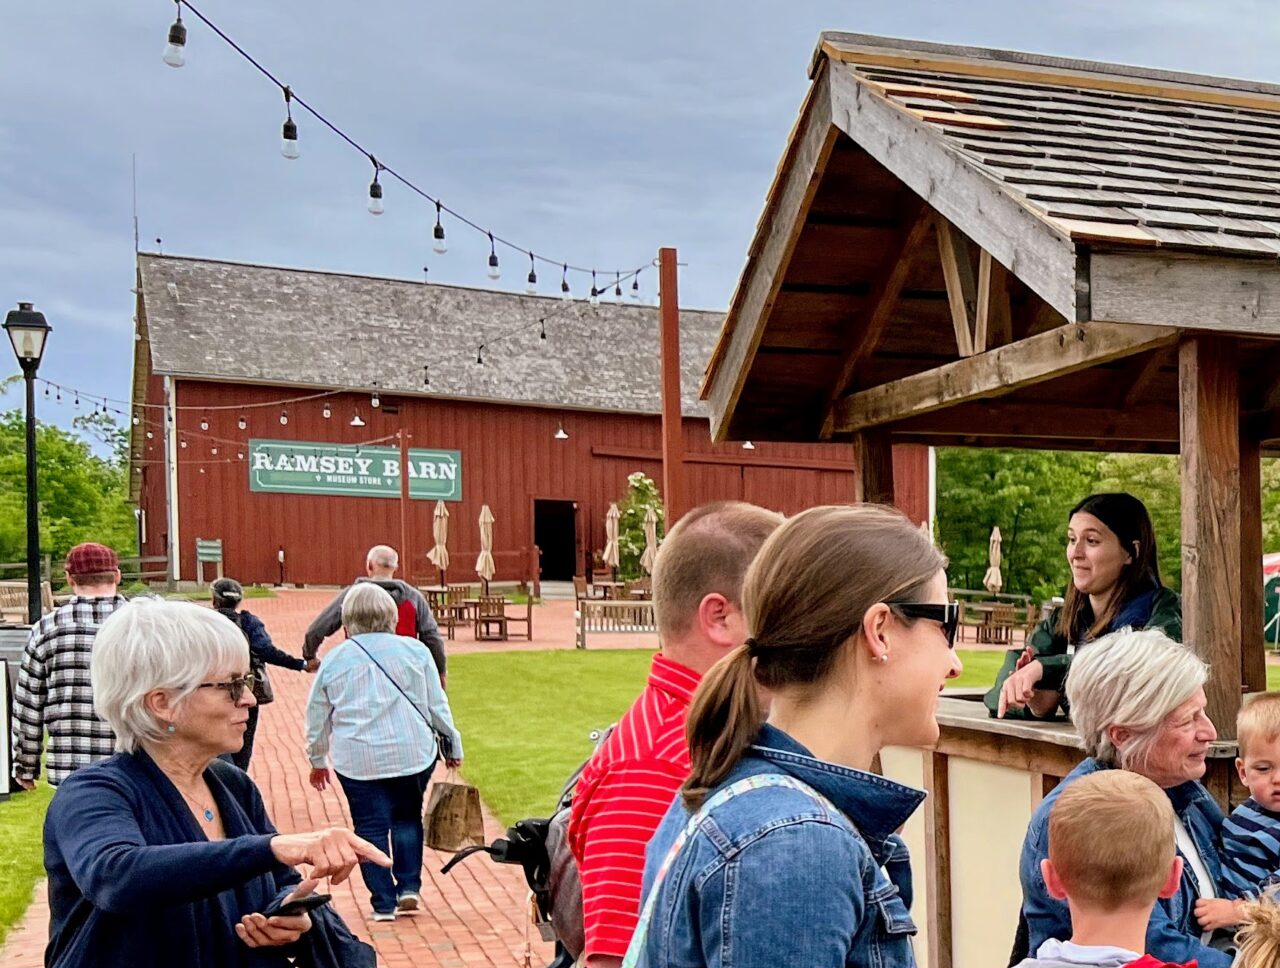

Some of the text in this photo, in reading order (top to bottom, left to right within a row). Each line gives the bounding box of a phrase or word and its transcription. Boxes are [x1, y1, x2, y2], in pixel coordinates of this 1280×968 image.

[252, 452, 458, 480] RAMSEY BARN
[326, 474, 382, 486] MUSEUM STORE
